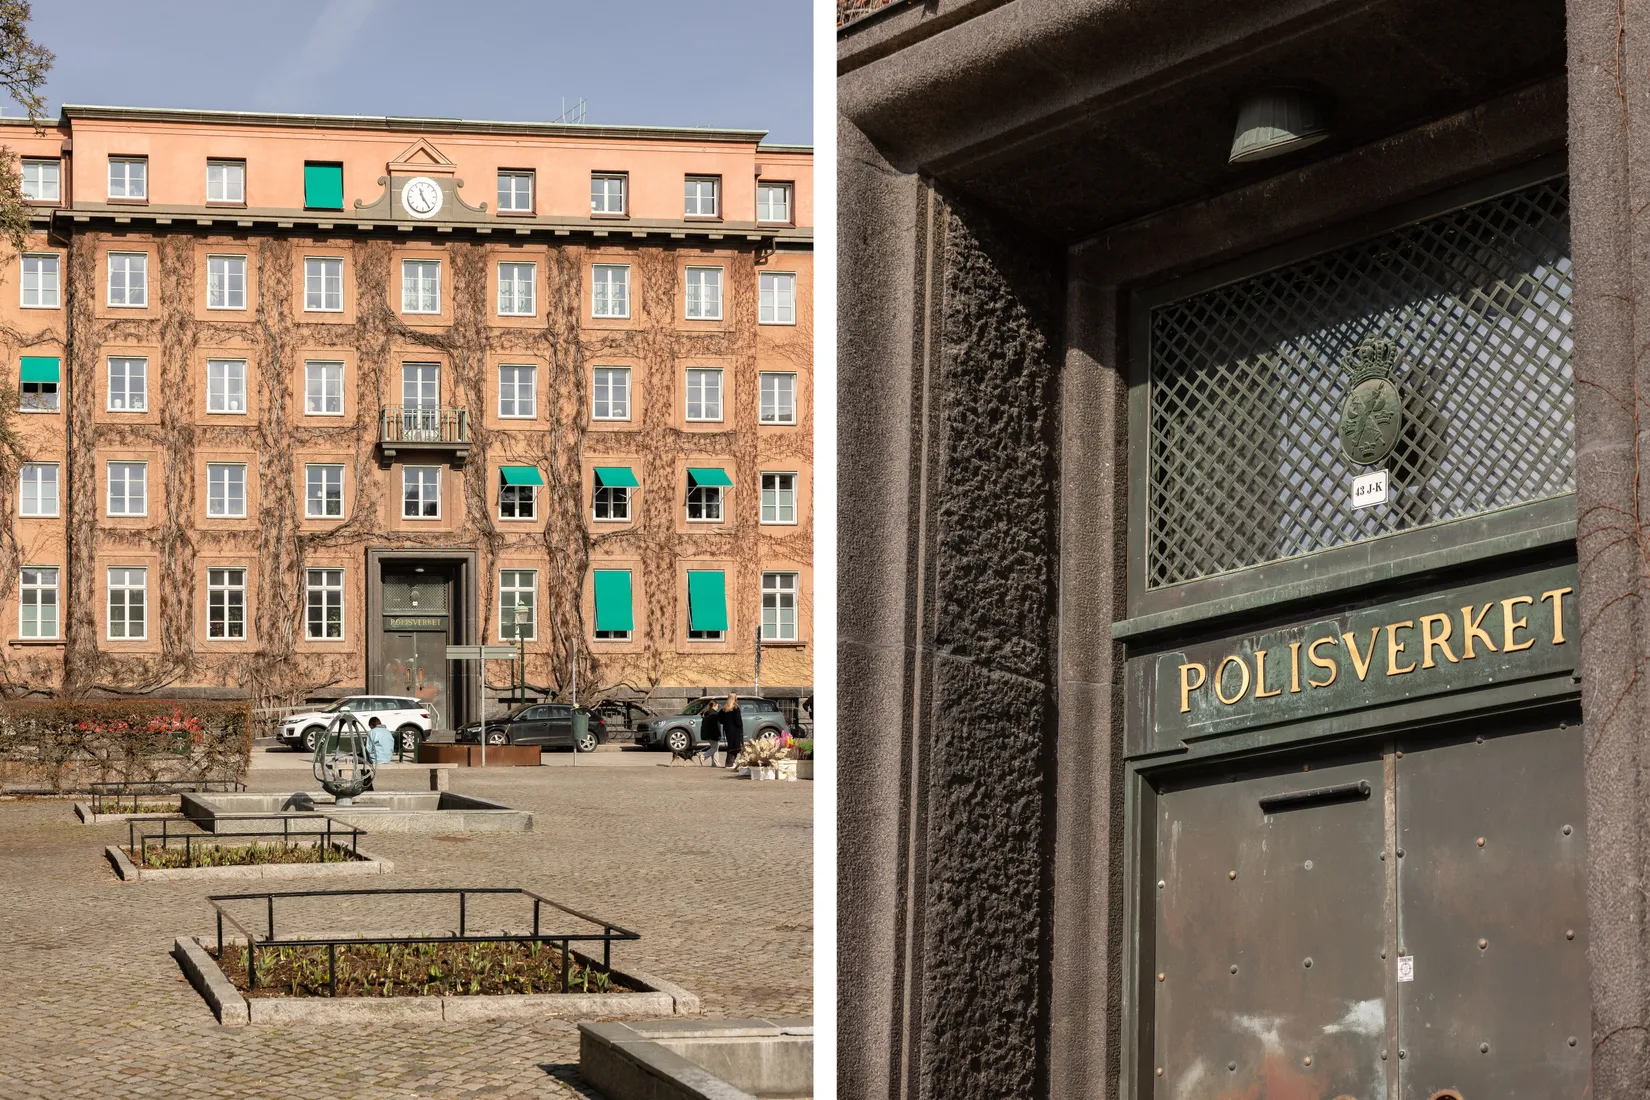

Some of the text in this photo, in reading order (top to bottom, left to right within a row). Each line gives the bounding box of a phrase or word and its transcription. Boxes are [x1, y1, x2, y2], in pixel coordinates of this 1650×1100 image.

[1355, 485, 1365, 497] 43
[390, 618, 441, 626] POLISVERKET
[1178, 587, 1573, 713] POLISVERKET
